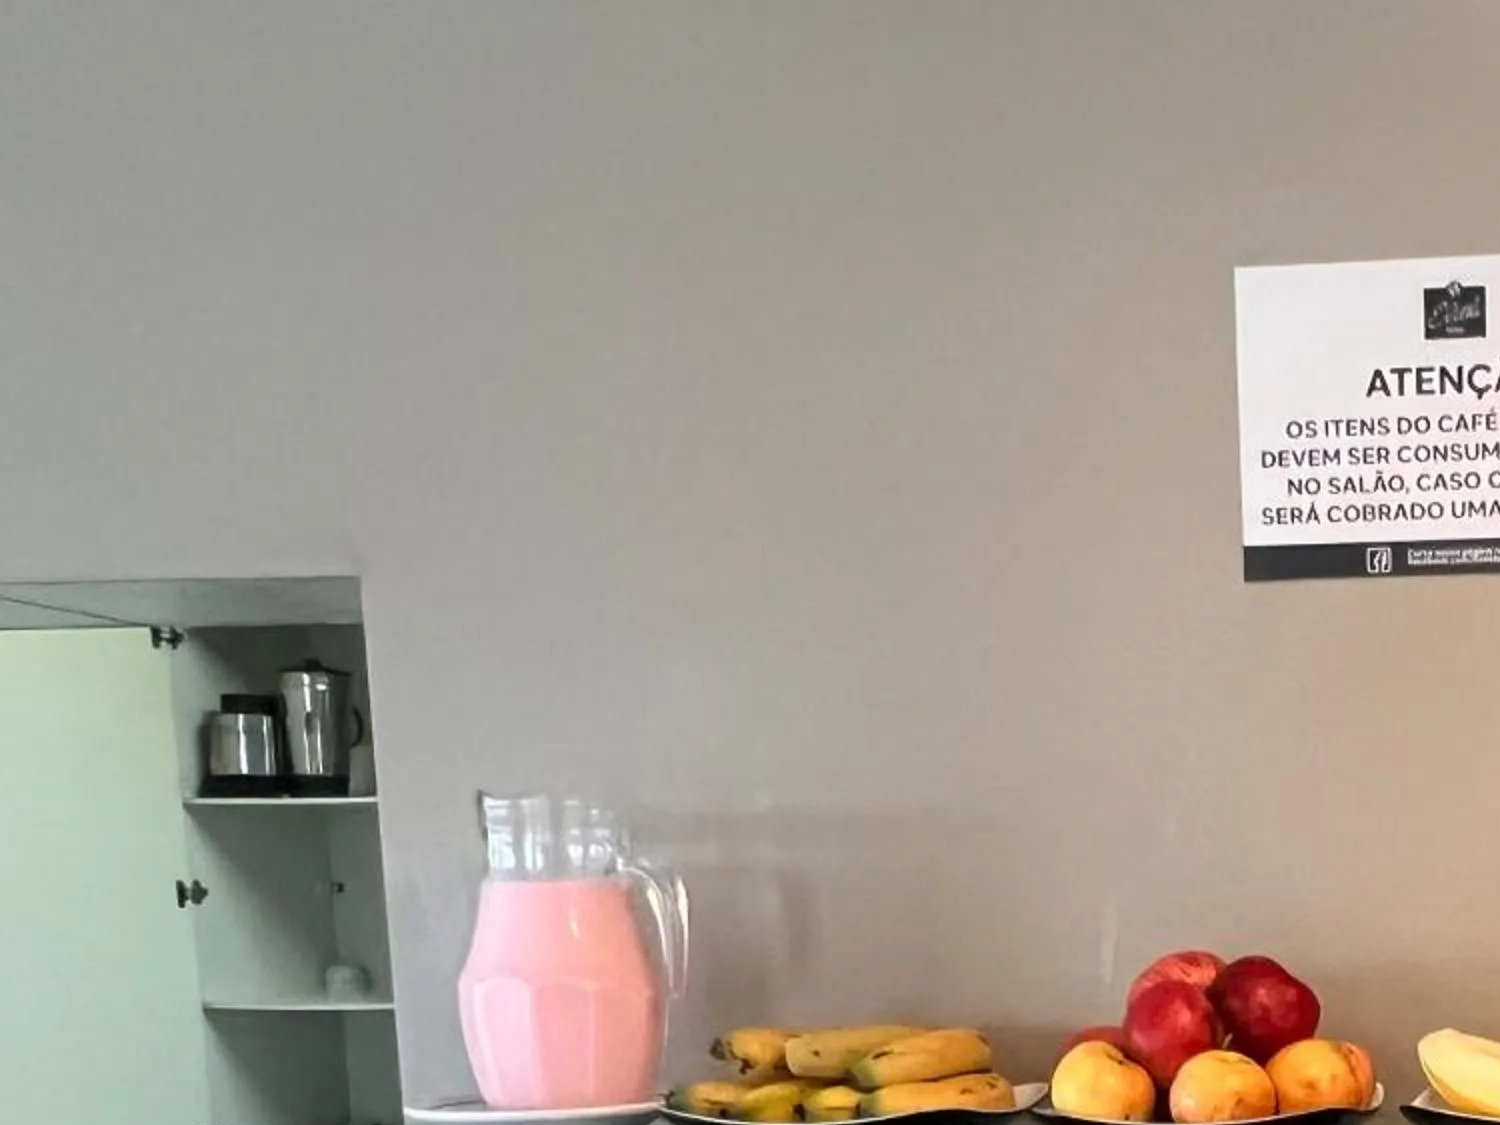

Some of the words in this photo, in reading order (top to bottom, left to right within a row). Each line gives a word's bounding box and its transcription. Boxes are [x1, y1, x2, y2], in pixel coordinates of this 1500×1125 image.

[1286, 420, 1318, 439] OS
[1325, 417, 1391, 438] ITENS
[1397, 416, 1431, 434] DO
[1438, 407, 1498, 433] CAFÉ
[1261, 449, 1341, 469] DEVEM
[1348, 446, 1390, 465] SER
[1287, 477, 1321, 497] NO
[1328, 470, 1410, 495] SALÃO,
[1416, 471, 1481, 492] CASO
[1262, 502, 1321, 525] SERÁ
[1327, 501, 1445, 523] COBRADO
